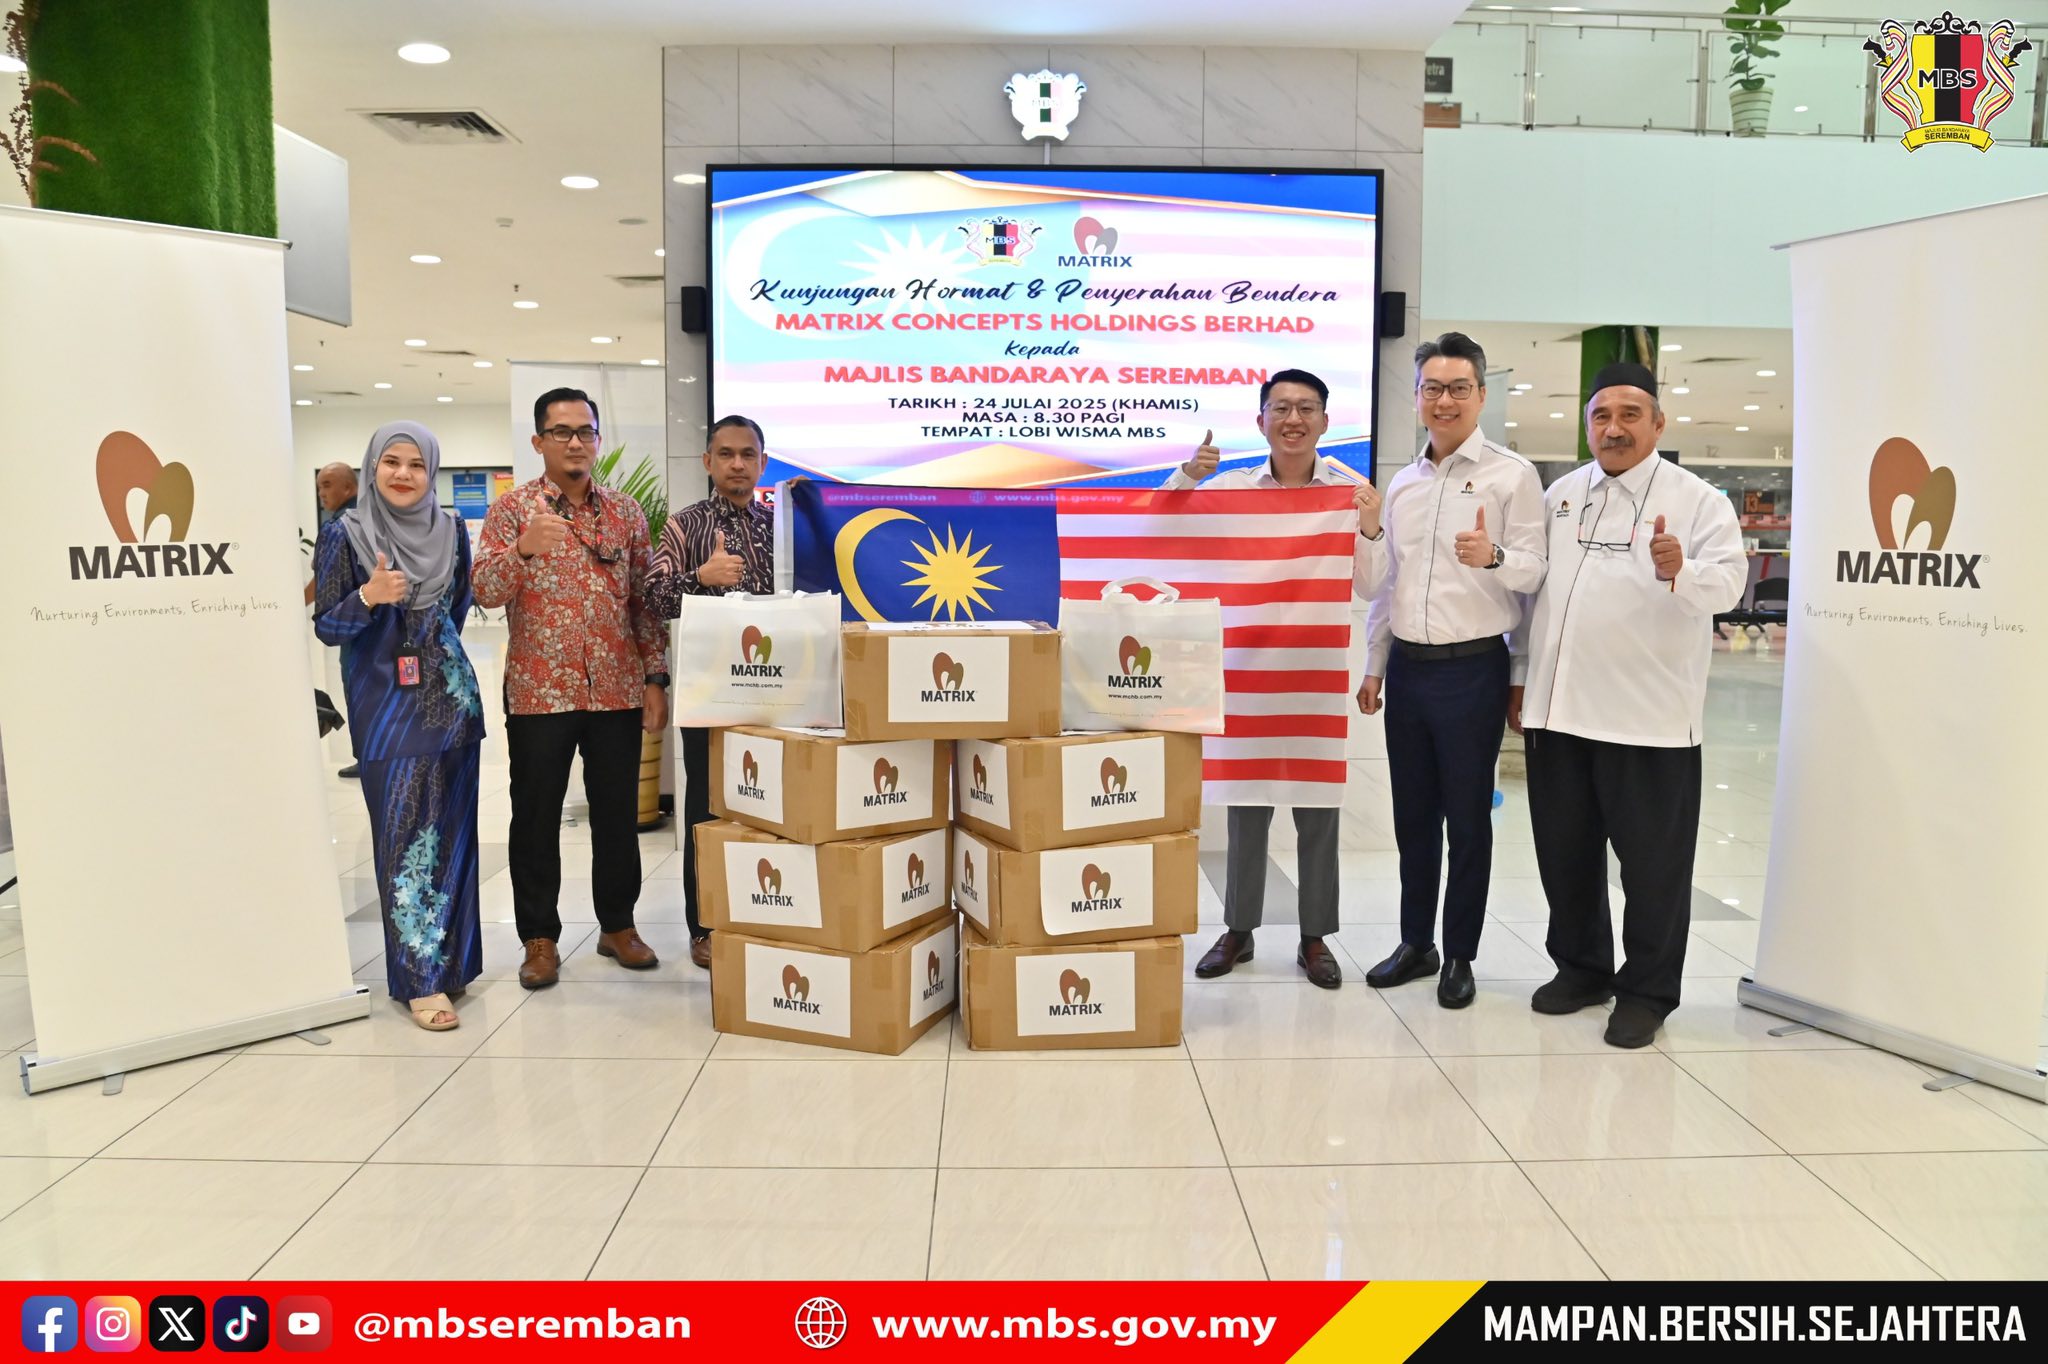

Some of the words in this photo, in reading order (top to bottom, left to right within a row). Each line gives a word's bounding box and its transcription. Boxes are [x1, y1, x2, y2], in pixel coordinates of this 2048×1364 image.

[986, 236, 1015, 244] MBS
[1058, 255, 1133, 267] MATRIX
[750, 278, 899, 306] Kunjungan
[906, 278, 1024, 301] Hormat
[1026, 278, 1046, 300] &
[1055, 278, 1216, 307] Penyerahan
[1222, 280, 1340, 304] Bendera
[776, 313, 885, 330] MATRIX
[892, 313, 1042, 331] CONCEPTS
[1050, 314, 1197, 332] HOLDINGS
[1204, 315, 1315, 333] BERHAD
[1004, 340, 1080, 359] kepada
[824, 366, 922, 383] MAJLIS
[931, 366, 1109, 384] BANDARAYA
[1118, 367, 1268, 385] SEREMBAN
[888, 398, 956, 409] TARIKH
[974, 398, 997, 409] 24
[1001, 398, 1051, 409] JULAI
[1058, 398, 1106, 409] 2025
[1112, 397, 1199, 412] (KHAMIS)
[962, 412, 1017, 423] MASA
[1034, 412, 1075, 423] 8.30
[1081, 412, 1125, 424] PAGI
[921, 426, 992, 437] TEMPAT
[1009, 426, 1050, 437] LOBI
[1056, 426, 1121, 438] WISMA
[1127, 426, 1166, 438] MBS
[994, 493, 1125, 504] www.mbs.gov.my
[68, 542, 235, 581] MATRIX
[1836, 550, 1983, 589] MATRIX
[30, 606, 98, 626] Nurturing
[104, 603, 187, 618] Environments,
[191, 598, 247, 618] Enriching
[250, 596, 282, 611] Lives.
[1804, 602, 1854, 626] Nurturing
[1859, 606, 1933, 627] Environments,
[1938, 611, 1988, 636] Enriching
[1994, 615, 2028, 633] Lives.
[731, 664, 783, 677] MATRIX
[1108, 675, 1162, 688] MATRIX
[921, 690, 976, 702] MATRIX
[737, 784, 765, 801] MATRIX
[863, 791, 907, 807] MATRIX
[970, 787, 994, 805] MATRIX
[1091, 791, 1137, 807] MATRIX
[752, 893, 793, 907] MATRIX
[901, 883, 930, 903] MATRIX
[961, 881, 978, 903] MATRIX
[1071, 897, 1122, 913] MATRIX
[923, 979, 944, 1001] MATRIX
[773, 997, 821, 1015] MATRIX
[1049, 1003, 1102, 1016] MATRIX
